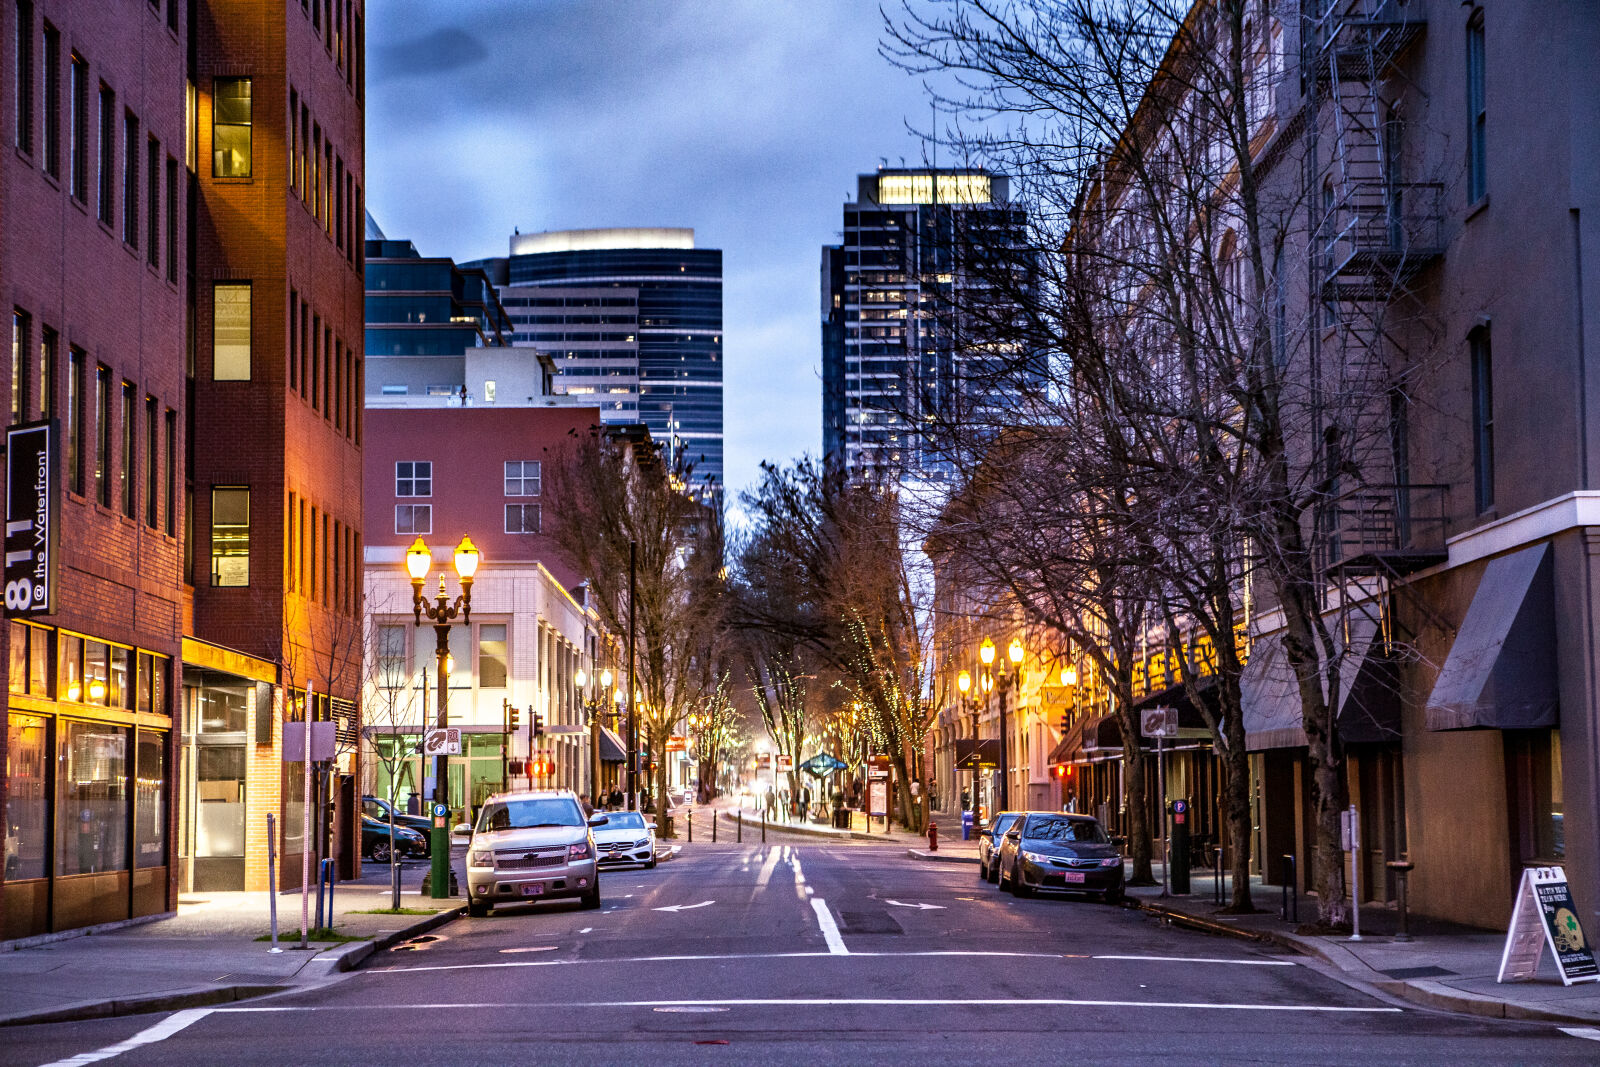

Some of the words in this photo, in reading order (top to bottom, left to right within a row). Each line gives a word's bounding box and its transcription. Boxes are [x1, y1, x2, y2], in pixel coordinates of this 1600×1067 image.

[34, 450, 46, 547] Waterfront
[5, 519, 33, 611] 811
[33, 551, 45, 579] the
[34, 584, 45, 601] @
